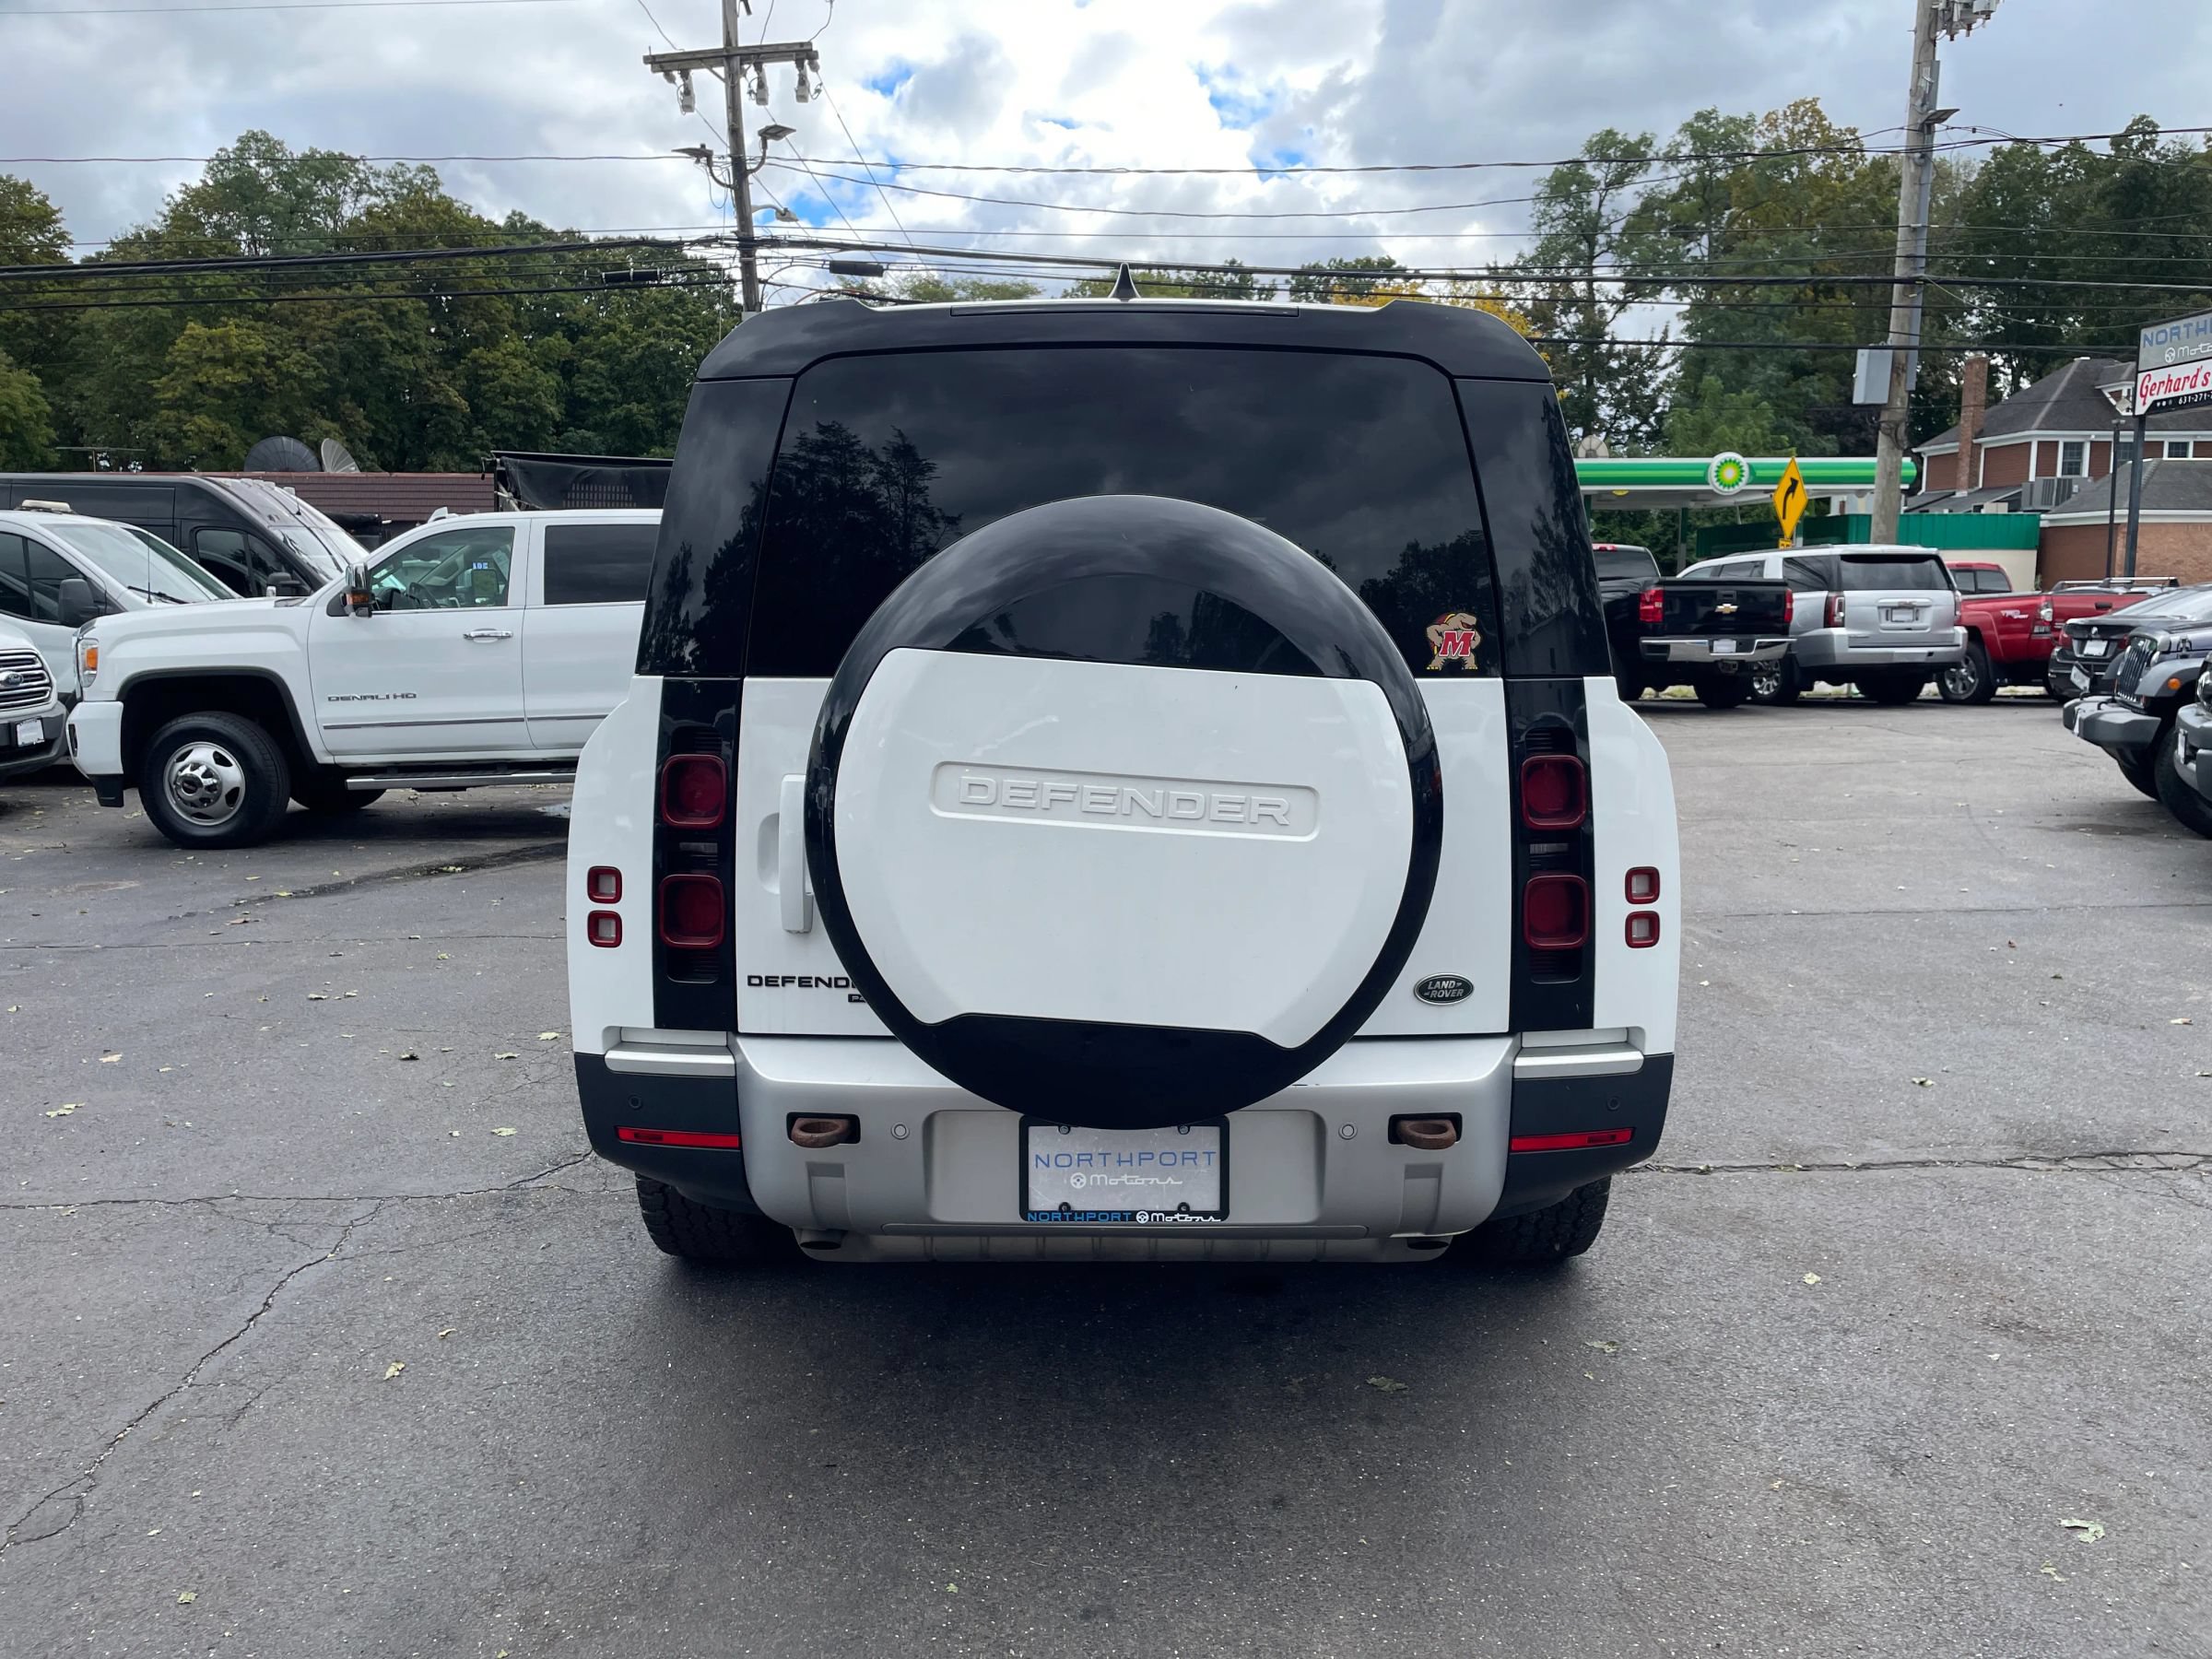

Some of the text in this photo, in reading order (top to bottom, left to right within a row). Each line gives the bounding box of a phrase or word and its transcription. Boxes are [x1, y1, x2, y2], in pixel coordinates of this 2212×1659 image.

[2143, 318, 2212, 348] NORTH
[2139, 365, 2211, 406] Gerhard's
[1439, 631, 1475, 656] M
[327, 693, 390, 701] DENALI
[959, 775, 1290, 827] DEFENDER
[747, 975, 856, 988] DEFEND
[1428, 980, 1456, 990] LAND
[1430, 989, 1464, 998] ROVER
[1035, 1151, 1217, 1169] NORTHPORT
[1089, 1173, 1183, 1185] Motors
[1028, 1211, 1221, 1222] NORTHPORT Motors
